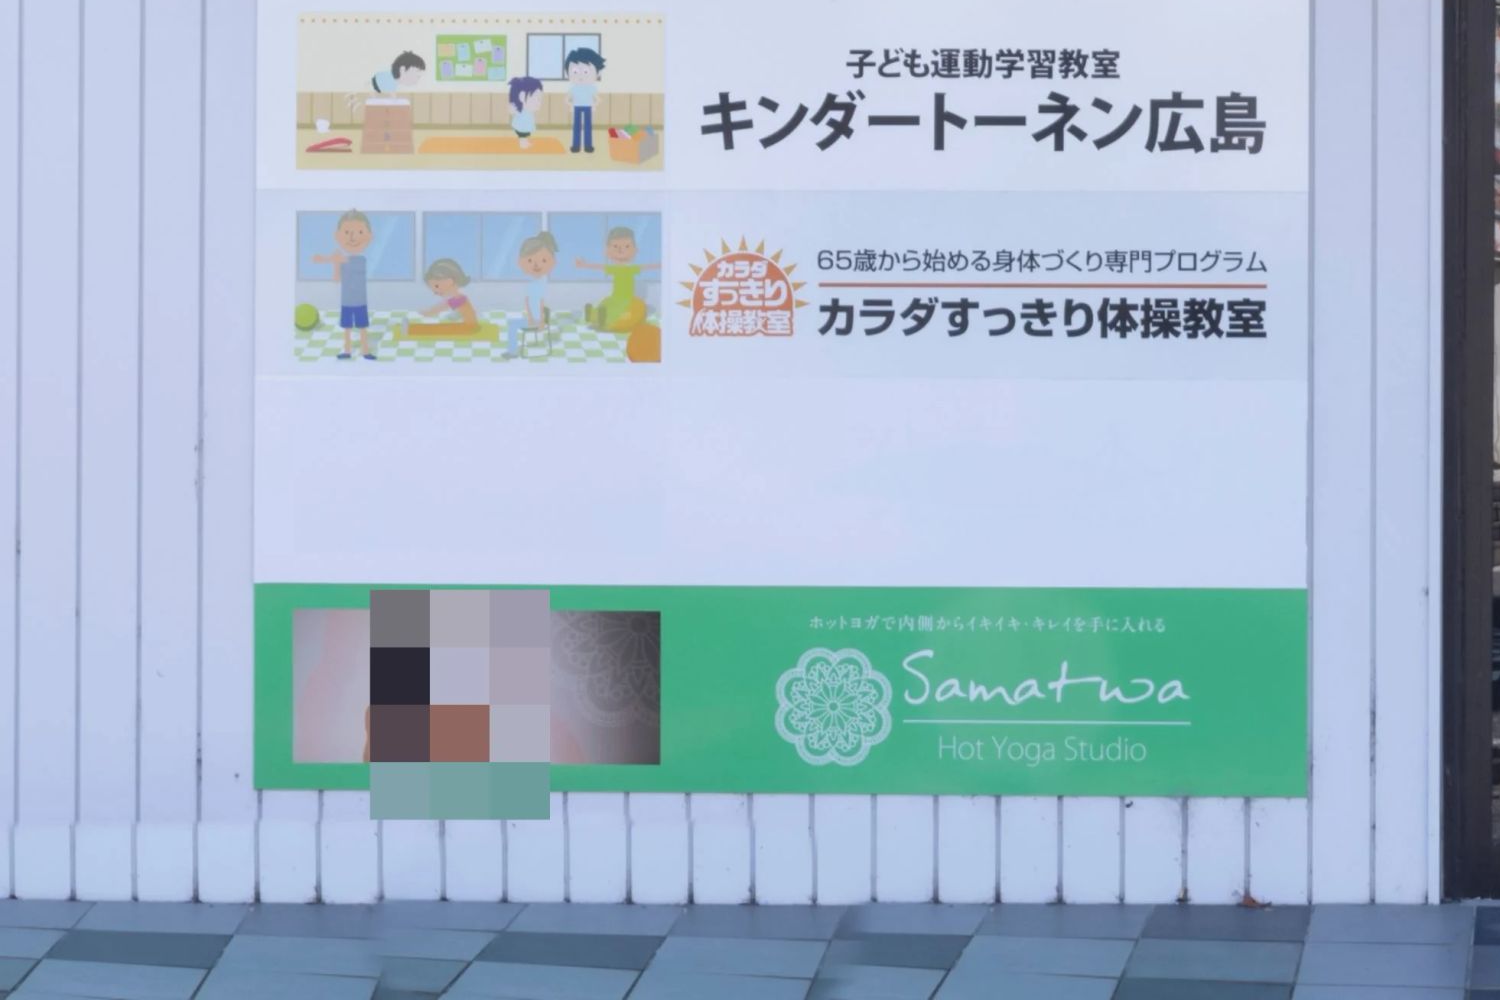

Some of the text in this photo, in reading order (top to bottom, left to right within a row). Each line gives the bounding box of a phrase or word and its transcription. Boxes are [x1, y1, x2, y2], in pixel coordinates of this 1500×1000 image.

[845, 47, 1121, 80] 子ども運動学習教室
[700, 90, 1267, 156] キンダートーネン広島
[717, 260, 768, 279] カラダ
[816, 248, 1268, 274] 65歳から始める身体づくり専門プログラム
[699, 278, 788, 307] すっきり
[691, 308, 792, 335] 体操教室
[817, 297, 1268, 340] カラダすっきり体操教室
[901, 649, 1191, 706] Samatwa
[938, 735, 1148, 768] Hot Yoga Studio
